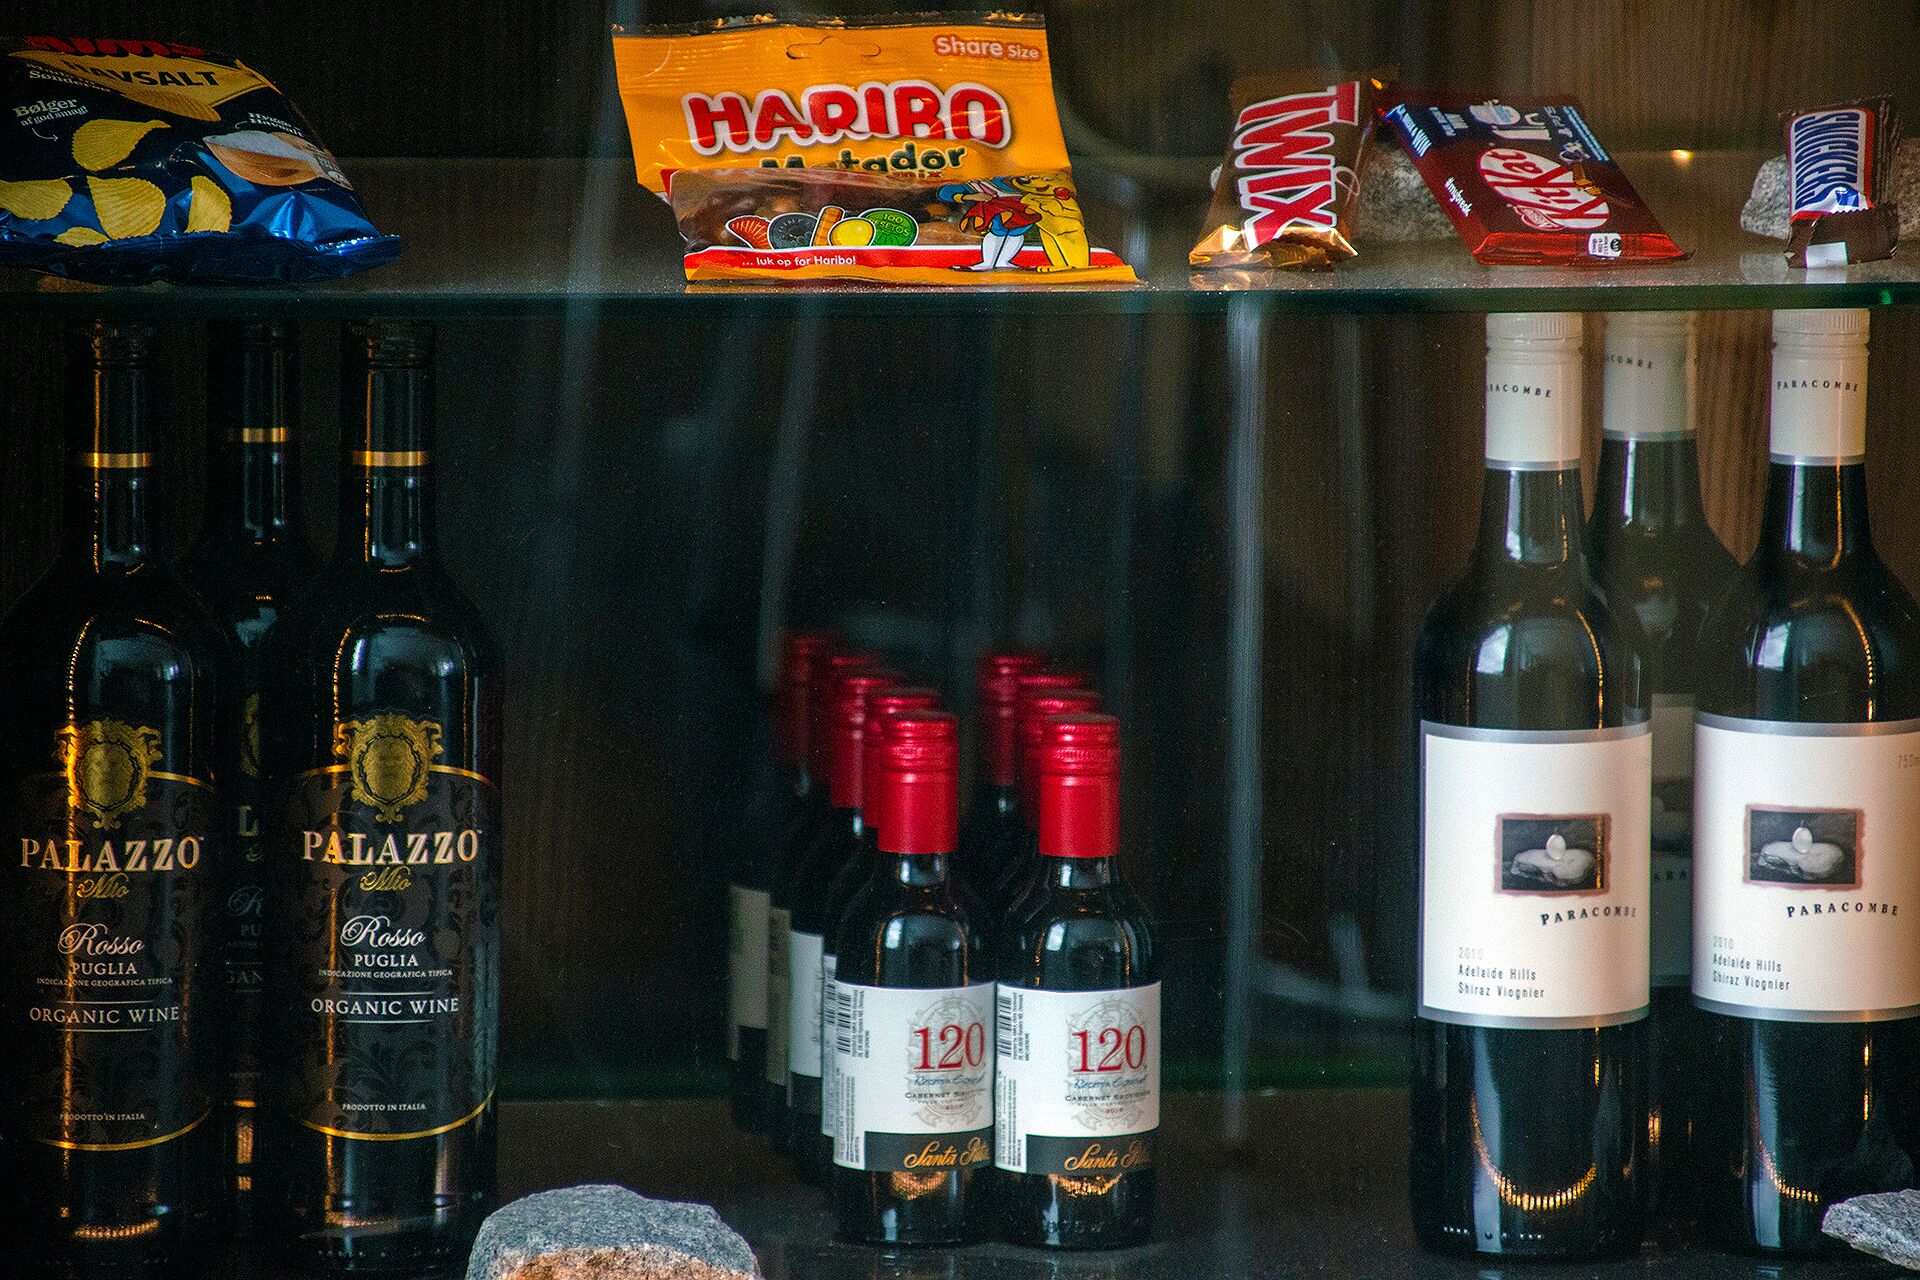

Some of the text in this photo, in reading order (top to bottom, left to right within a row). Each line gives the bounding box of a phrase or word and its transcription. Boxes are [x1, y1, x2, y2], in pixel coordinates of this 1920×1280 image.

[934, 34, 1040, 60] Share Size
[12, 99, 78, 117] Bølger
[683, 80, 1009, 155] HARIBO
[33, 112, 55, 124] god
[759, 143, 968, 174] Mtador
[1234, 81, 1360, 252] TWIX
[1794, 112, 1860, 210] SNICKERS
[1444, 176, 1474, 218] #mybreak
[883, 214, 904, 223] 100
[756, 255, 773, 266] luk
[777, 258, 792, 268] op
[795, 255, 811, 266] for
[813, 255, 857, 266] Haribo!
[20, 836, 201, 873] PALAZZO
[302, 829, 479, 867] PALAZZO
[1541, 906, 1637, 926] PARACOMBE
[1786, 902, 1899, 918] PARACOMBE
[57, 923, 144, 955] Rosso
[340, 915, 426, 948] Rosso
[1458, 946, 1484, 960] 2010
[1713, 937, 1735, 950] 2010
[71, 962, 138, 975] PUGLIA
[354, 953, 419, 967] PUGLIA
[1712, 952, 1782, 973] Adelaide Hills
[36, 977, 89, 987] INDICAZIONE
[90, 978, 145, 987] GEOGRAFICA
[319, 968, 453, 979] INDICAZIONE GEOGRAFICA TIPICA
[1458, 964, 1536, 981] Adelaide Hills
[1712, 970, 1791, 991] Shiraz Viognier
[1458, 981, 1545, 1000] Shiraz Viognier
[29, 1006, 180, 1024] ORGANIC WINE
[311, 998, 459, 1015] ORGANIC WINE
[912, 1021, 986, 1071] 120
[1072, 1024, 1147, 1074] 120
[342, 1103, 385, 1111] PRODOTTO
[387, 1103, 397, 1111] IN
[59, 1113, 103, 1121] PRODOTTO
[903, 1140, 957, 1169] Santa
[1063, 1143, 1118, 1171] Santa
